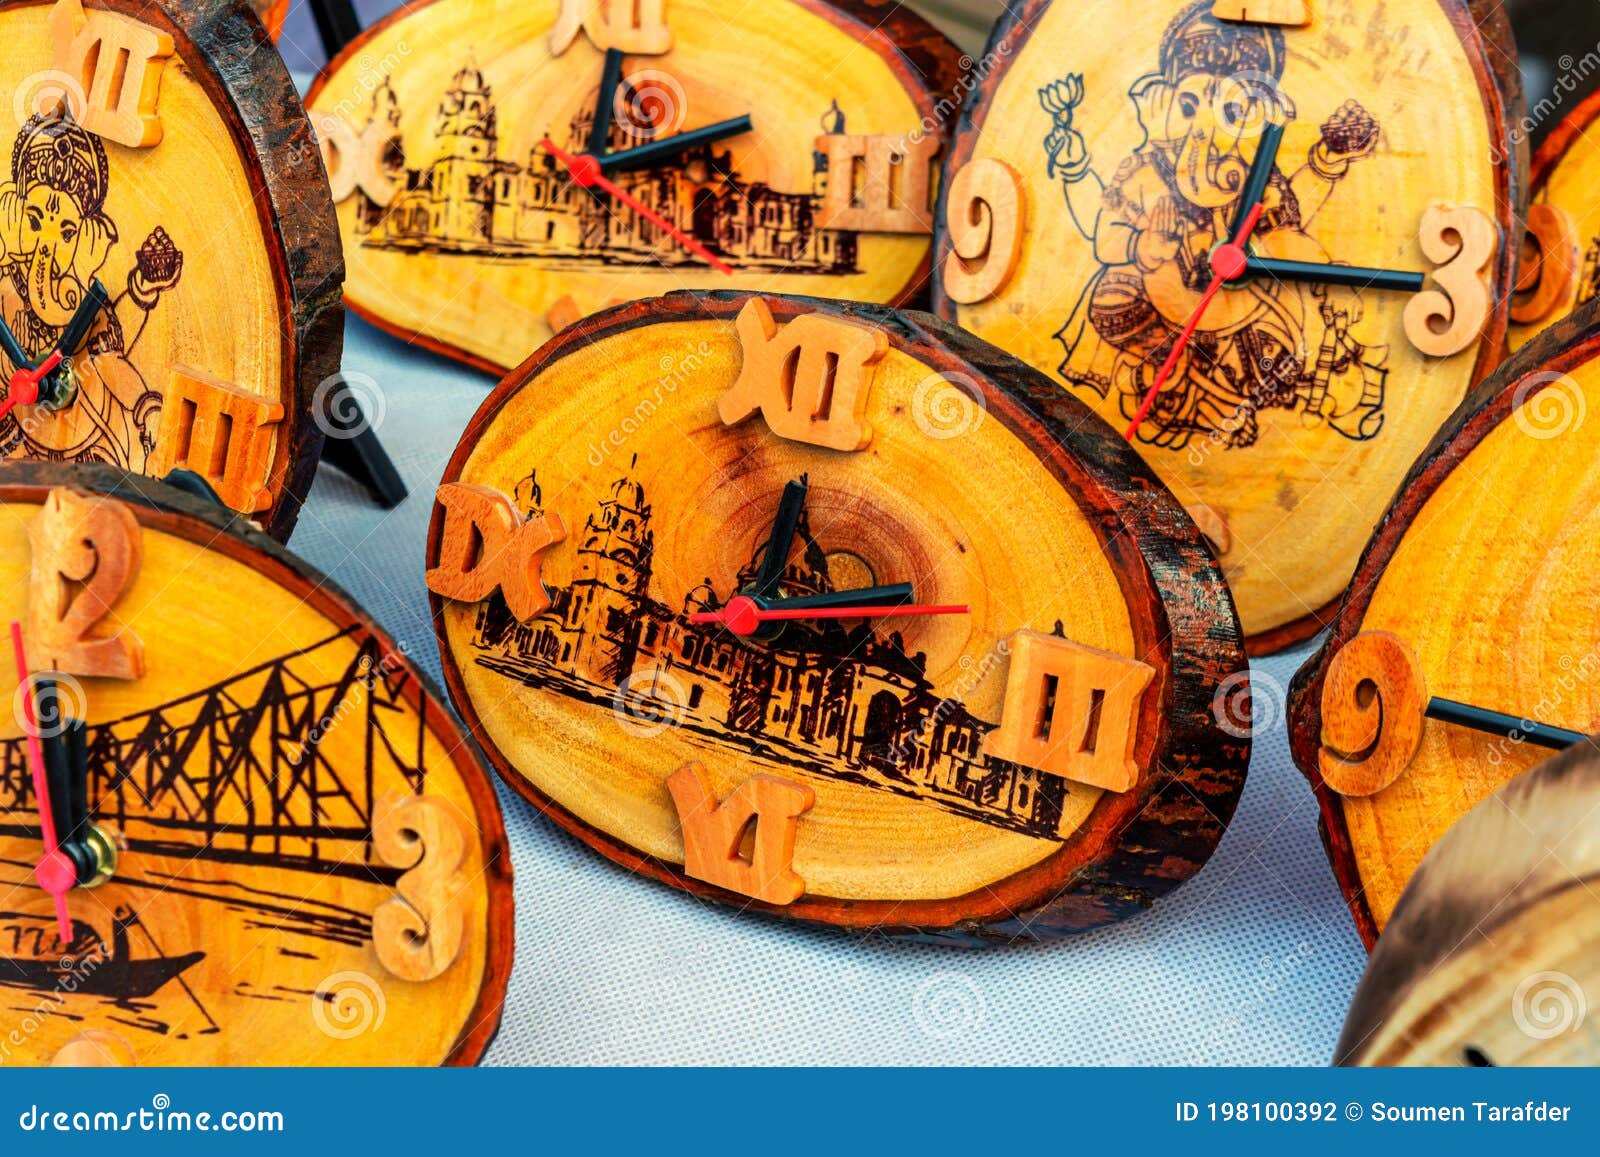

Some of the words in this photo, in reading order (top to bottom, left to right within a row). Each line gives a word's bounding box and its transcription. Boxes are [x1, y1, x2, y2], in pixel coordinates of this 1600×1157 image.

[943, 157, 1026, 306] 9
[1403, 204, 1497, 357] 3
[717, 295, 890, 452] XII
[426, 482, 567, 623] IX
[982, 628, 1157, 793] III
[1318, 630, 1427, 797] 9
[371, 790, 473, 983] 3
